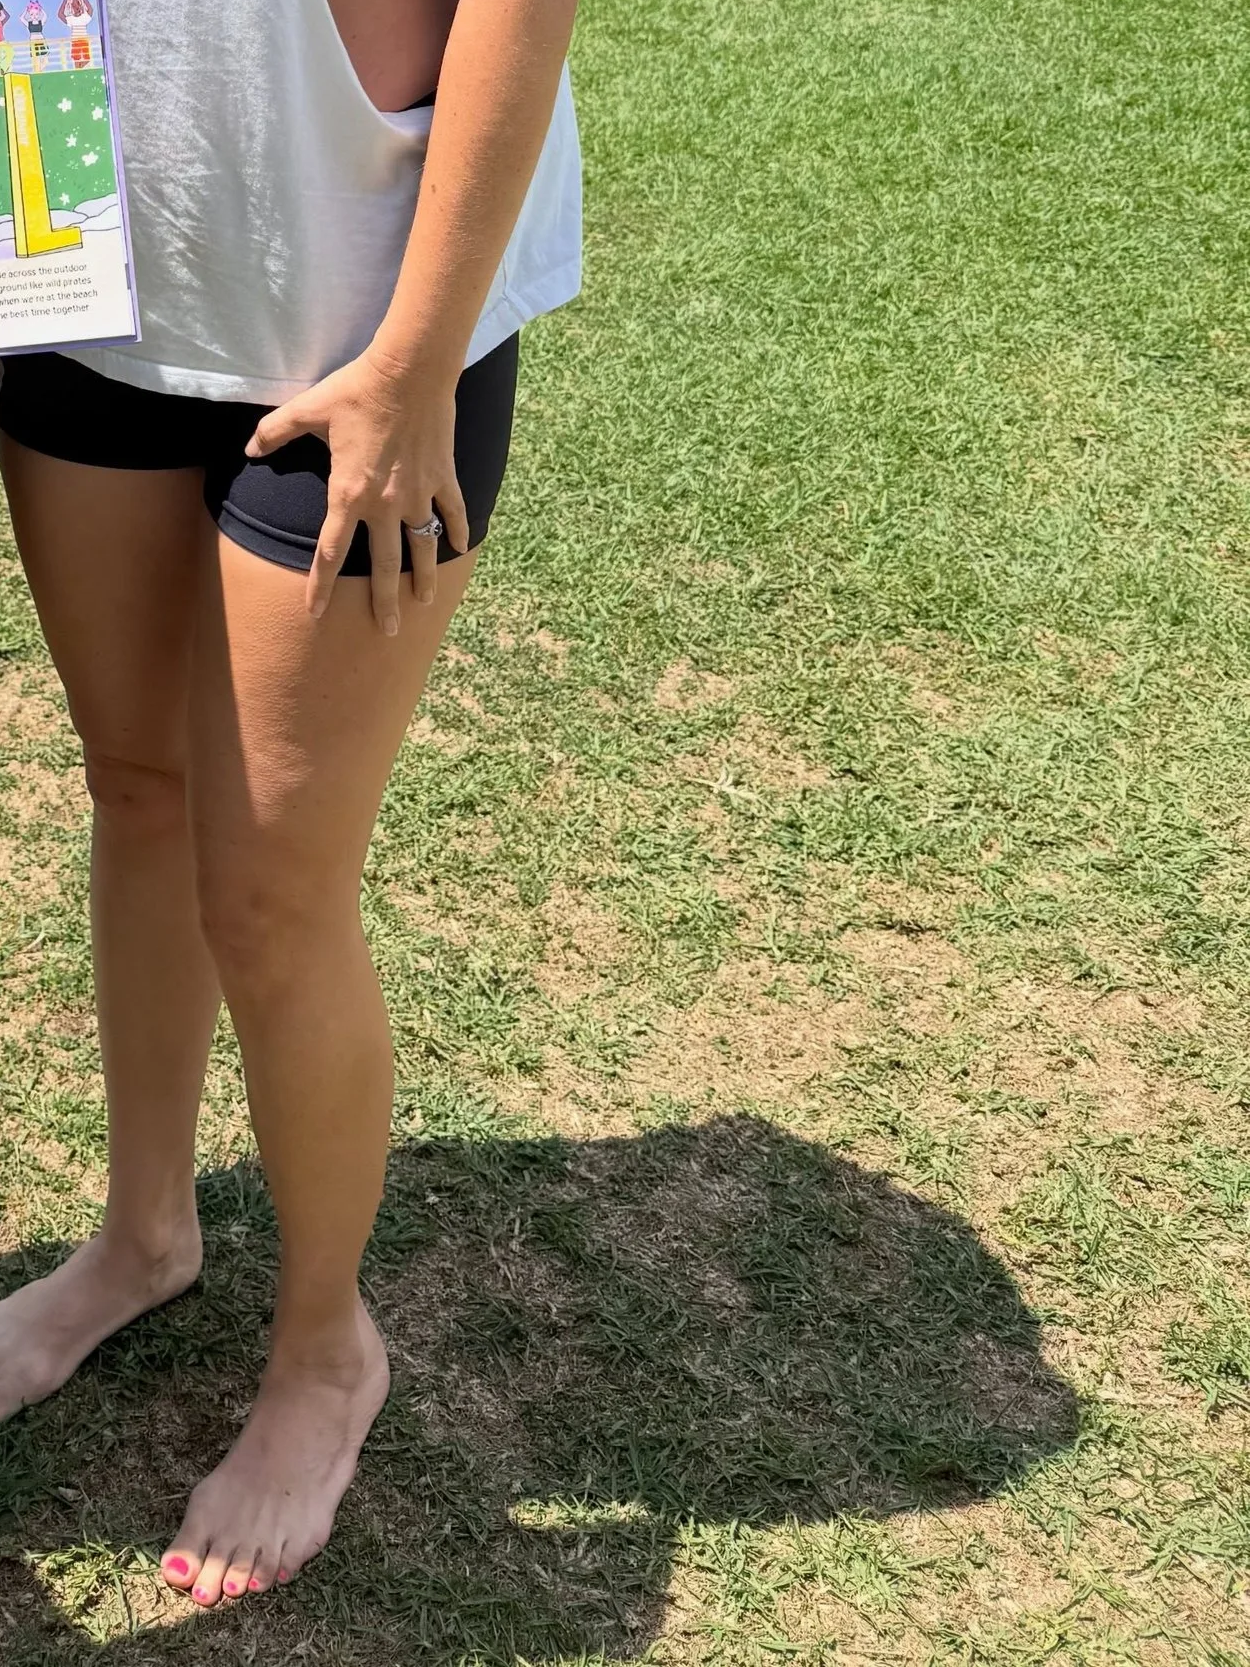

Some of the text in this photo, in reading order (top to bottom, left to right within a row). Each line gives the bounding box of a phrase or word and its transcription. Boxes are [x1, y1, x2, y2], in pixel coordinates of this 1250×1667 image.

[8, 269, 37, 278] across
[38, 267, 53, 275] the
[54, 264, 87, 274] outdoor
[29, 281, 44, 289] like
[45, 279, 61, 288] wild
[63, 276, 92, 287] pirates
[46, 293, 56, 302] at
[57, 291, 71, 300] the
[73, 289, 98, 299] beach
[10, 308, 29, 318] best
[31, 307, 51, 317] time
